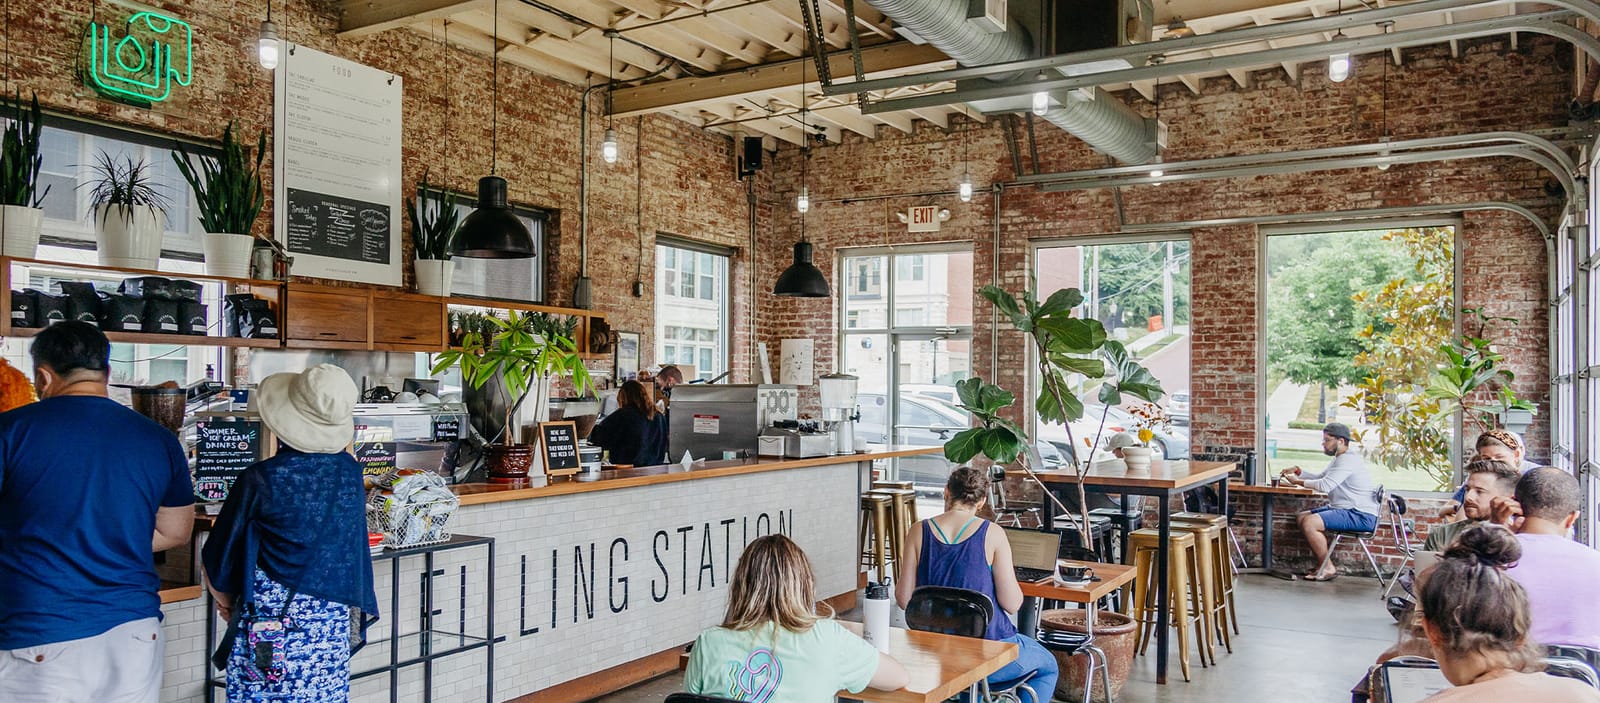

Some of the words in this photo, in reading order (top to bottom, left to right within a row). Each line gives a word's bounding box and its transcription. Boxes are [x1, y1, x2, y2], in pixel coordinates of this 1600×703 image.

[914, 207, 934, 224] EXIT
[202, 427, 238, 437] SUMMER
[223, 434, 250, 442] CREAM
[420, 537, 628, 657] FILING
